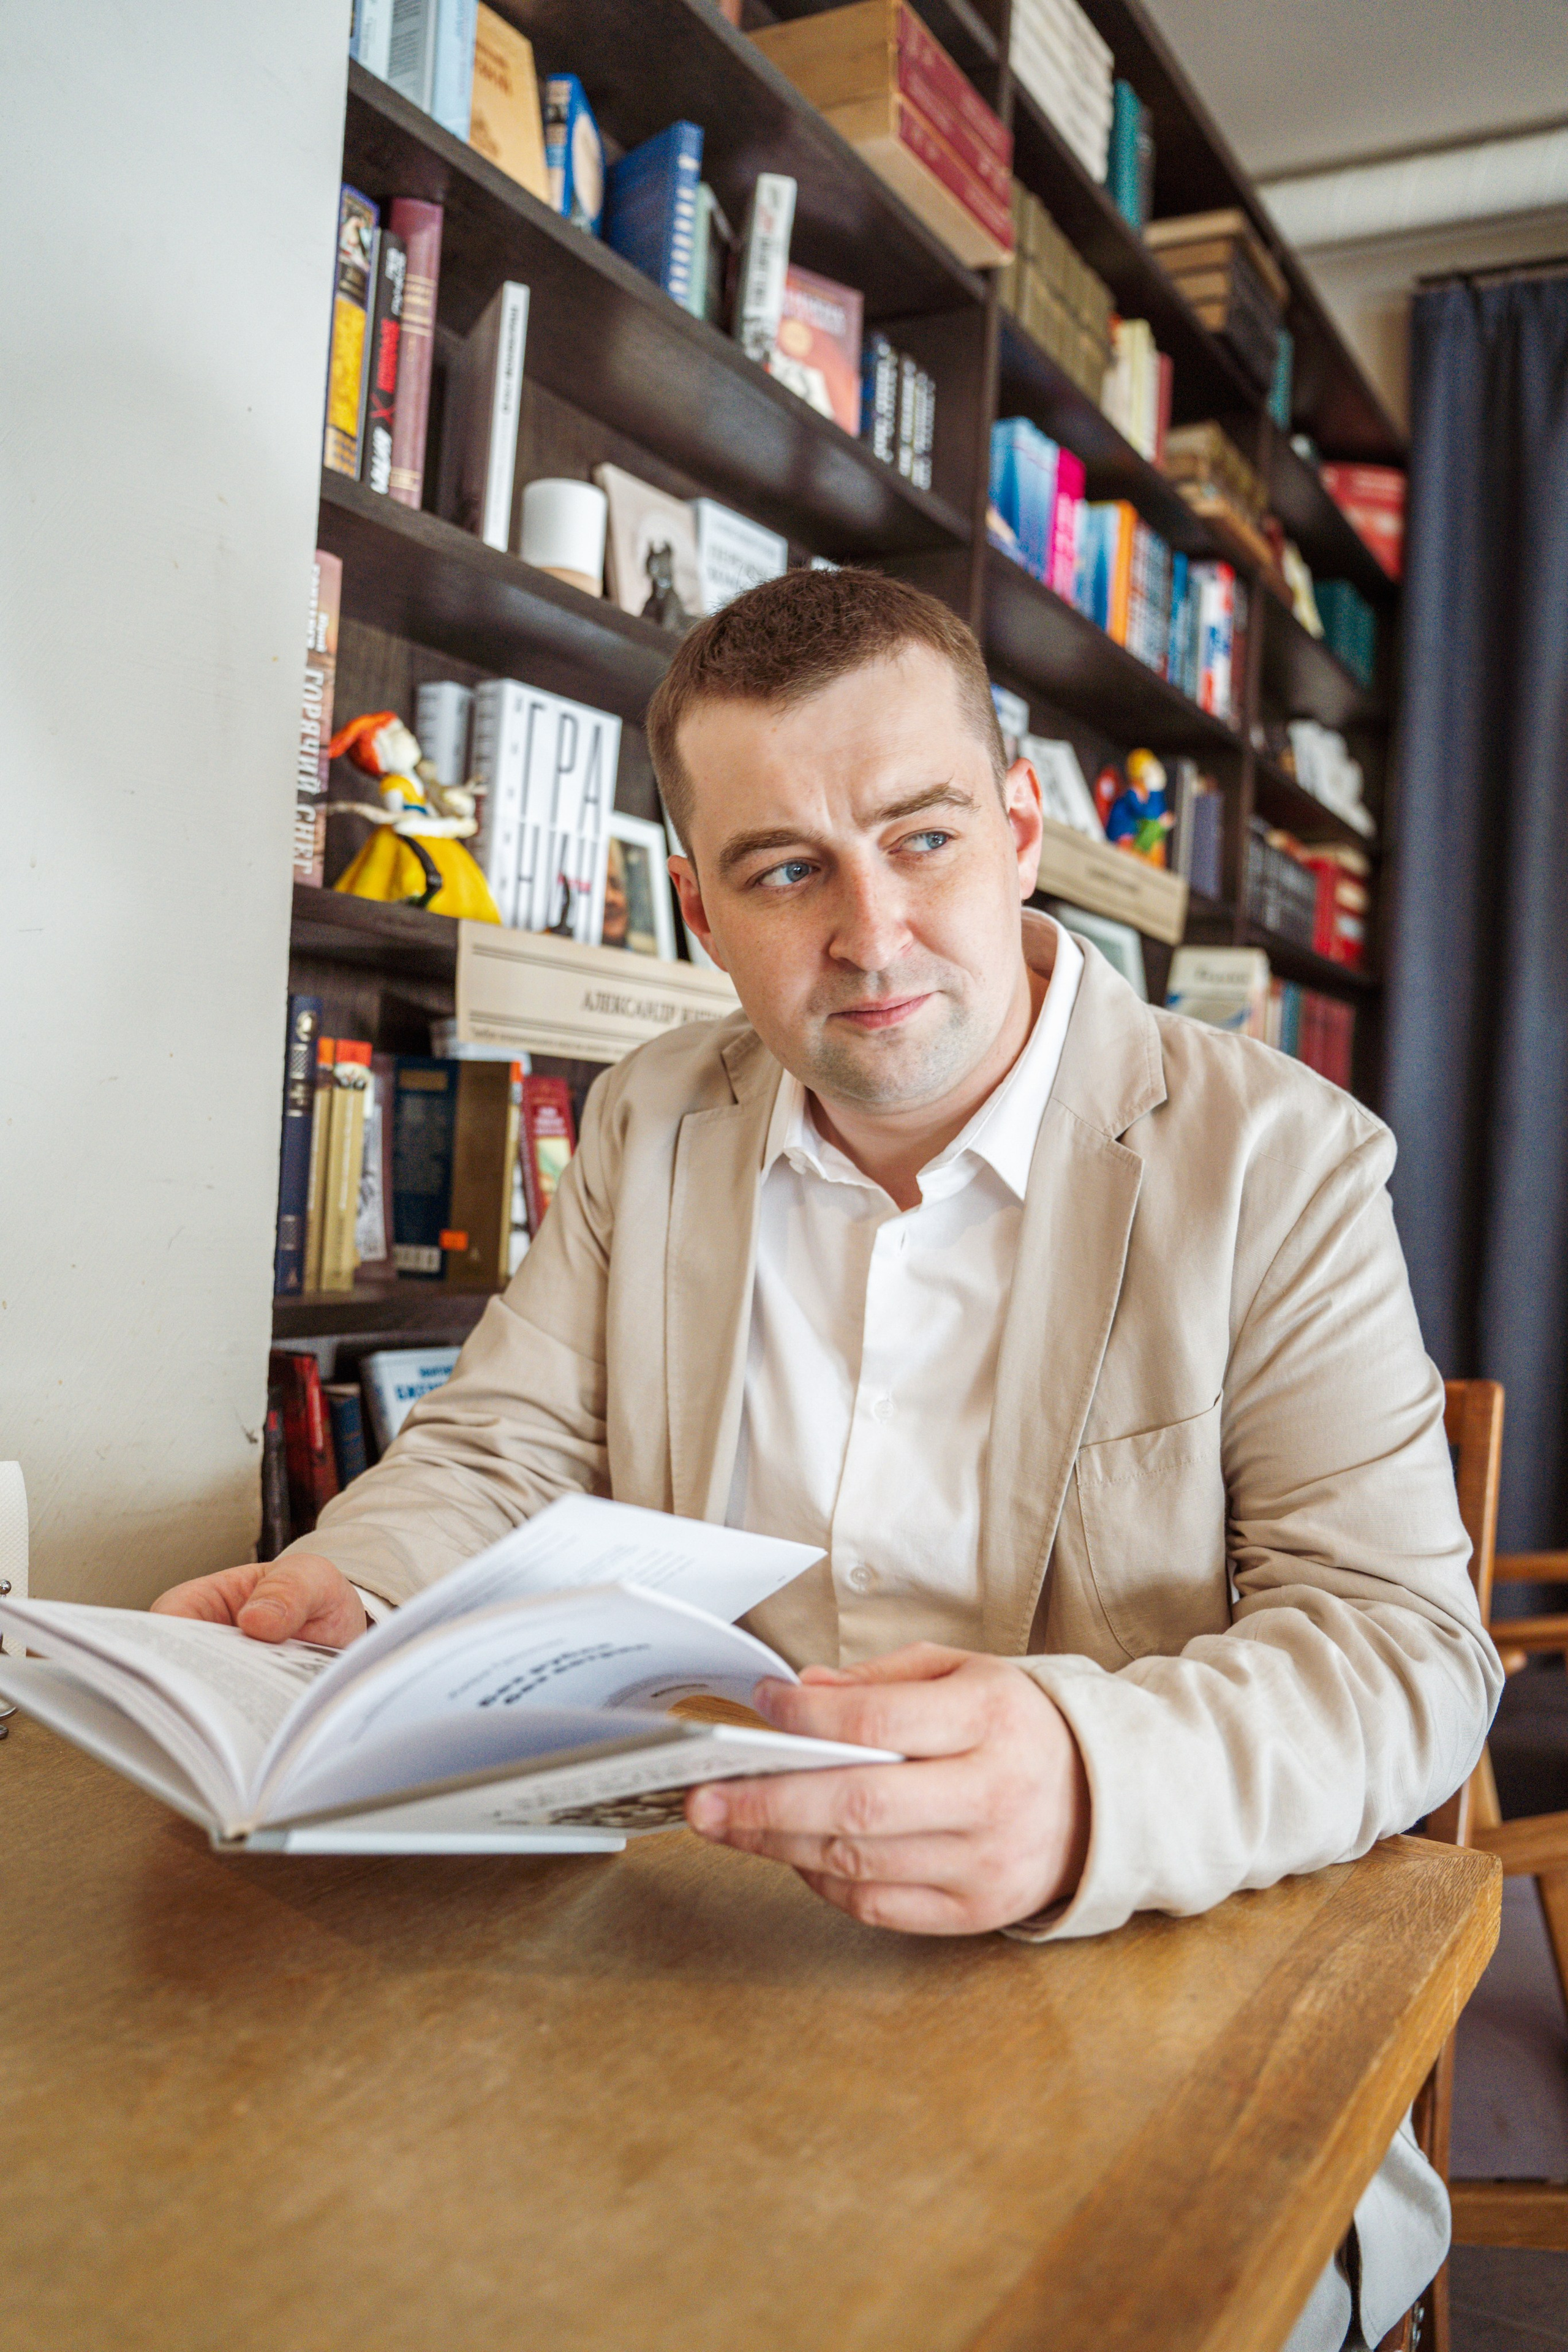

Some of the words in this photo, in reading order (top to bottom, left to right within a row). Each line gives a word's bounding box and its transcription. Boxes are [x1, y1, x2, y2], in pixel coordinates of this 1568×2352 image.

[298, 668, 325, 795] ГОРЯЧИЙ
[520, 701, 601, 837] ГРА
[293, 804, 317, 875] СНЕГ
